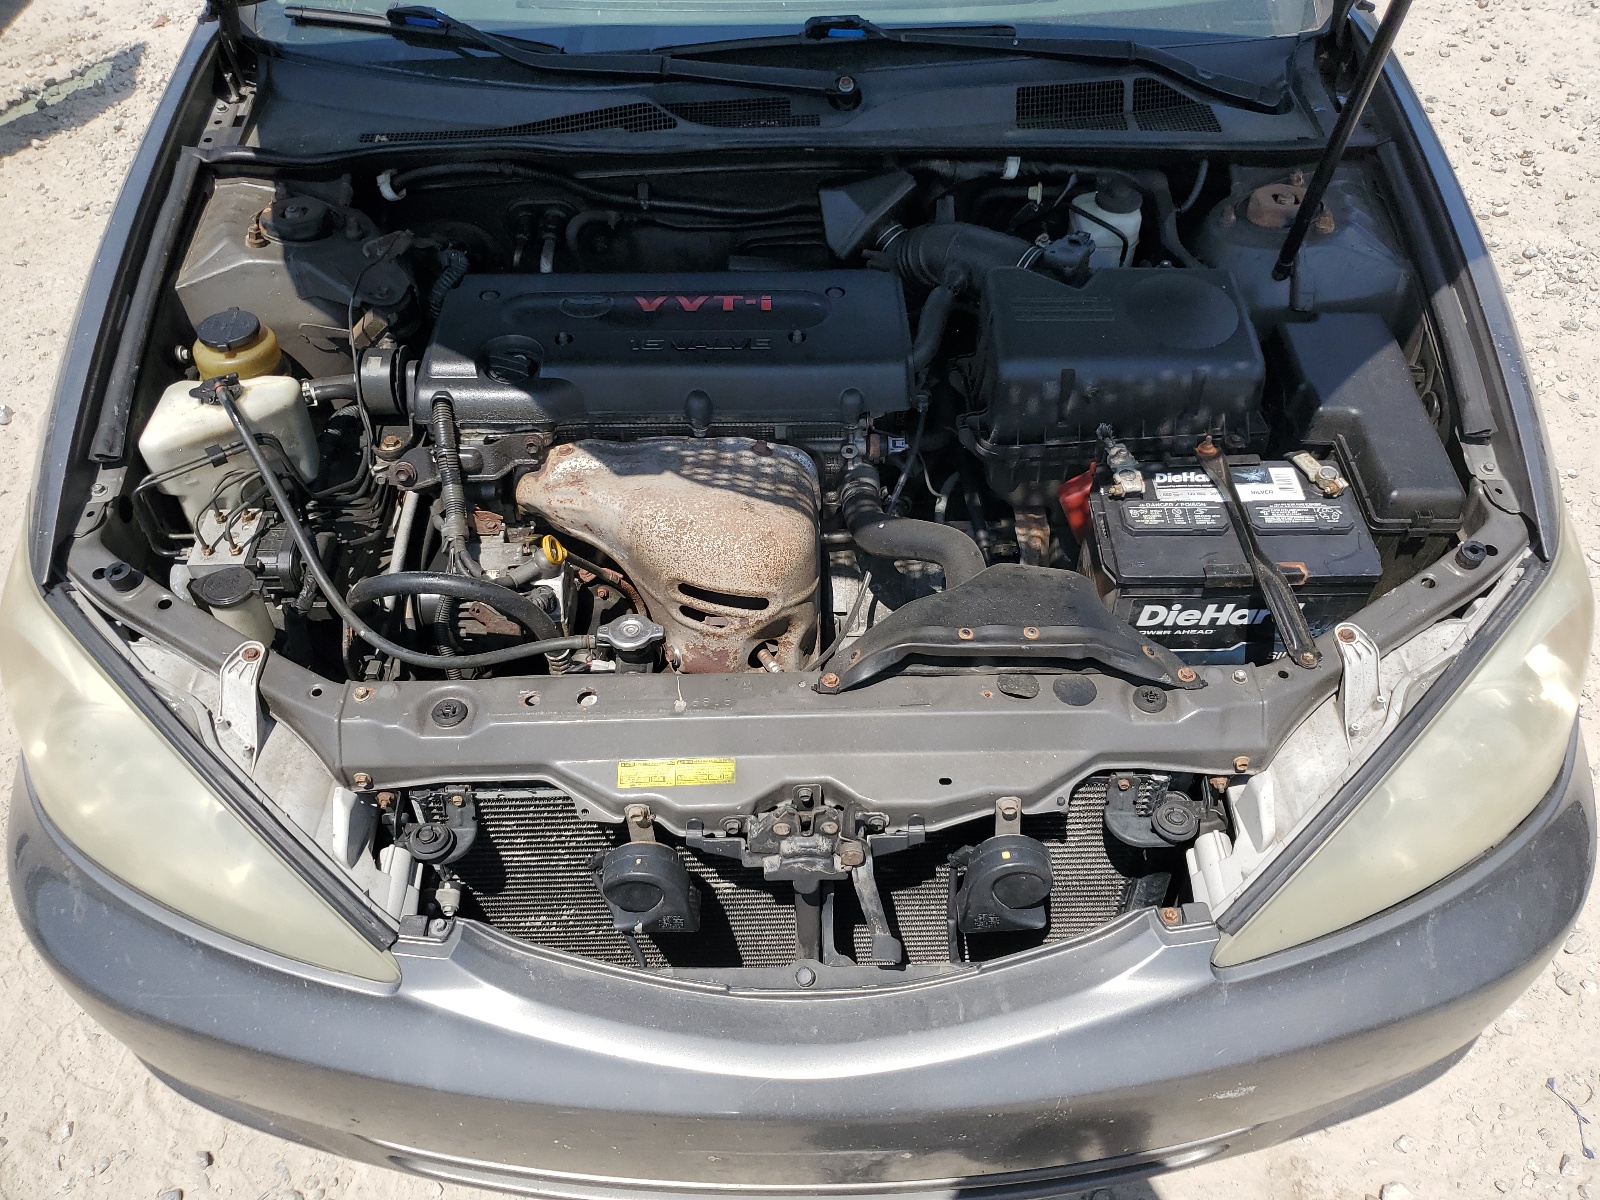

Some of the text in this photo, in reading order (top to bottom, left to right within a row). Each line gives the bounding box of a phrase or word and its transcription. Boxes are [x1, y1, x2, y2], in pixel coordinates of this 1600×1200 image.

[670, 338, 771, 351] VALVE
[1155, 471, 1211, 483] DieHa
[1136, 603, 1305, 626] DieHar
